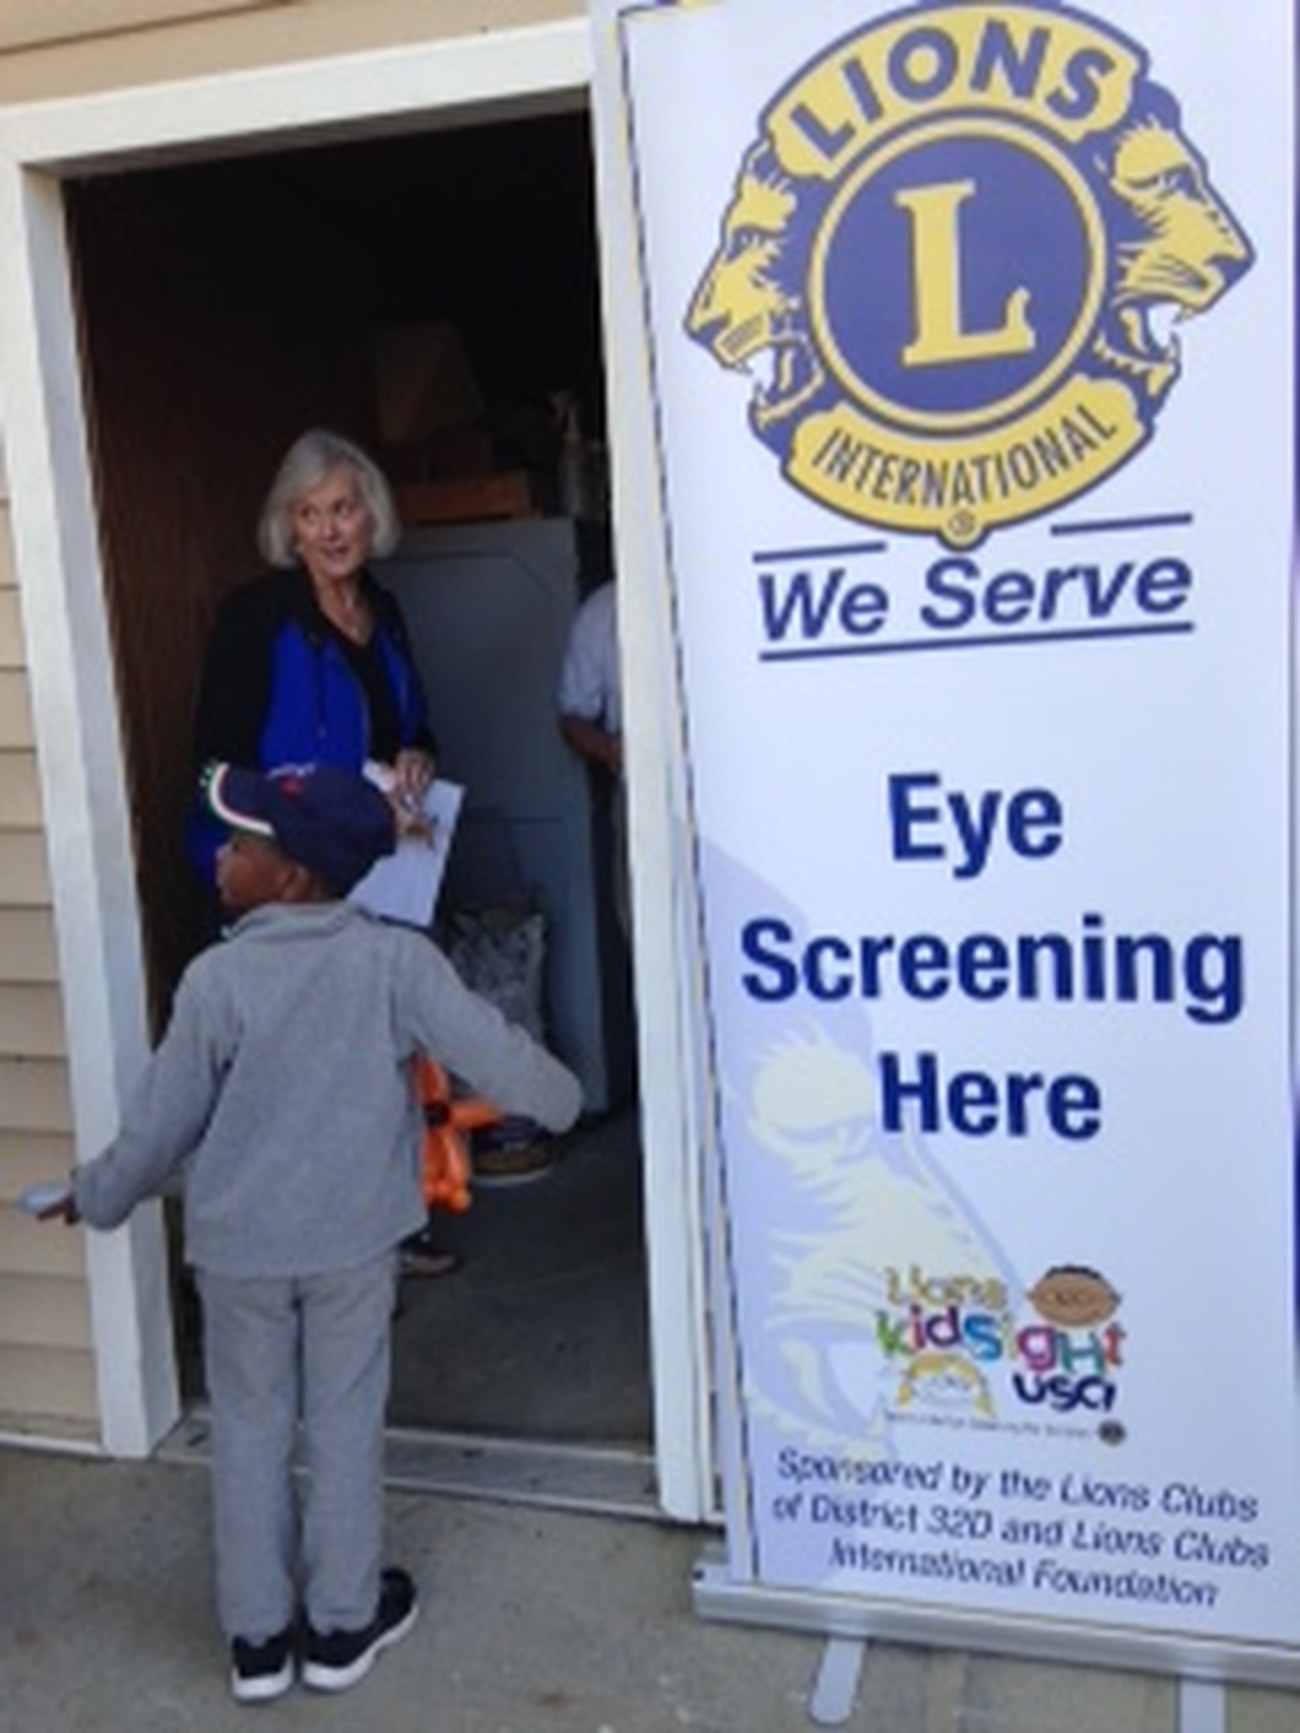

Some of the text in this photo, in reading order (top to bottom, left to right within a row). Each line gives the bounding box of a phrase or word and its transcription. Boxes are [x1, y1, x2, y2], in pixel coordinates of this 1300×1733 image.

[789, 19, 1116, 162] LIONS
[894, 179, 1036, 367] L
[811, 403, 1118, 507] INTERNATIONAL
[758, 555, 1193, 640] We Serve
[888, 773, 1063, 879] Eye
[741, 913, 1245, 1025] Screening
[879, 1051, 1102, 1141] Here
[773, 1493, 802, 1521] of
[811, 1493, 917, 1533] District
[1001, 1517, 1063, 1547] and
[1072, 1519, 1164, 1556] Lions
[1174, 1529, 1270, 1570] Clubs
[778, 1447, 1259, 1522] Sponsored by the Lions Clubs
[829, 1537, 1219, 1607] International Foundation
